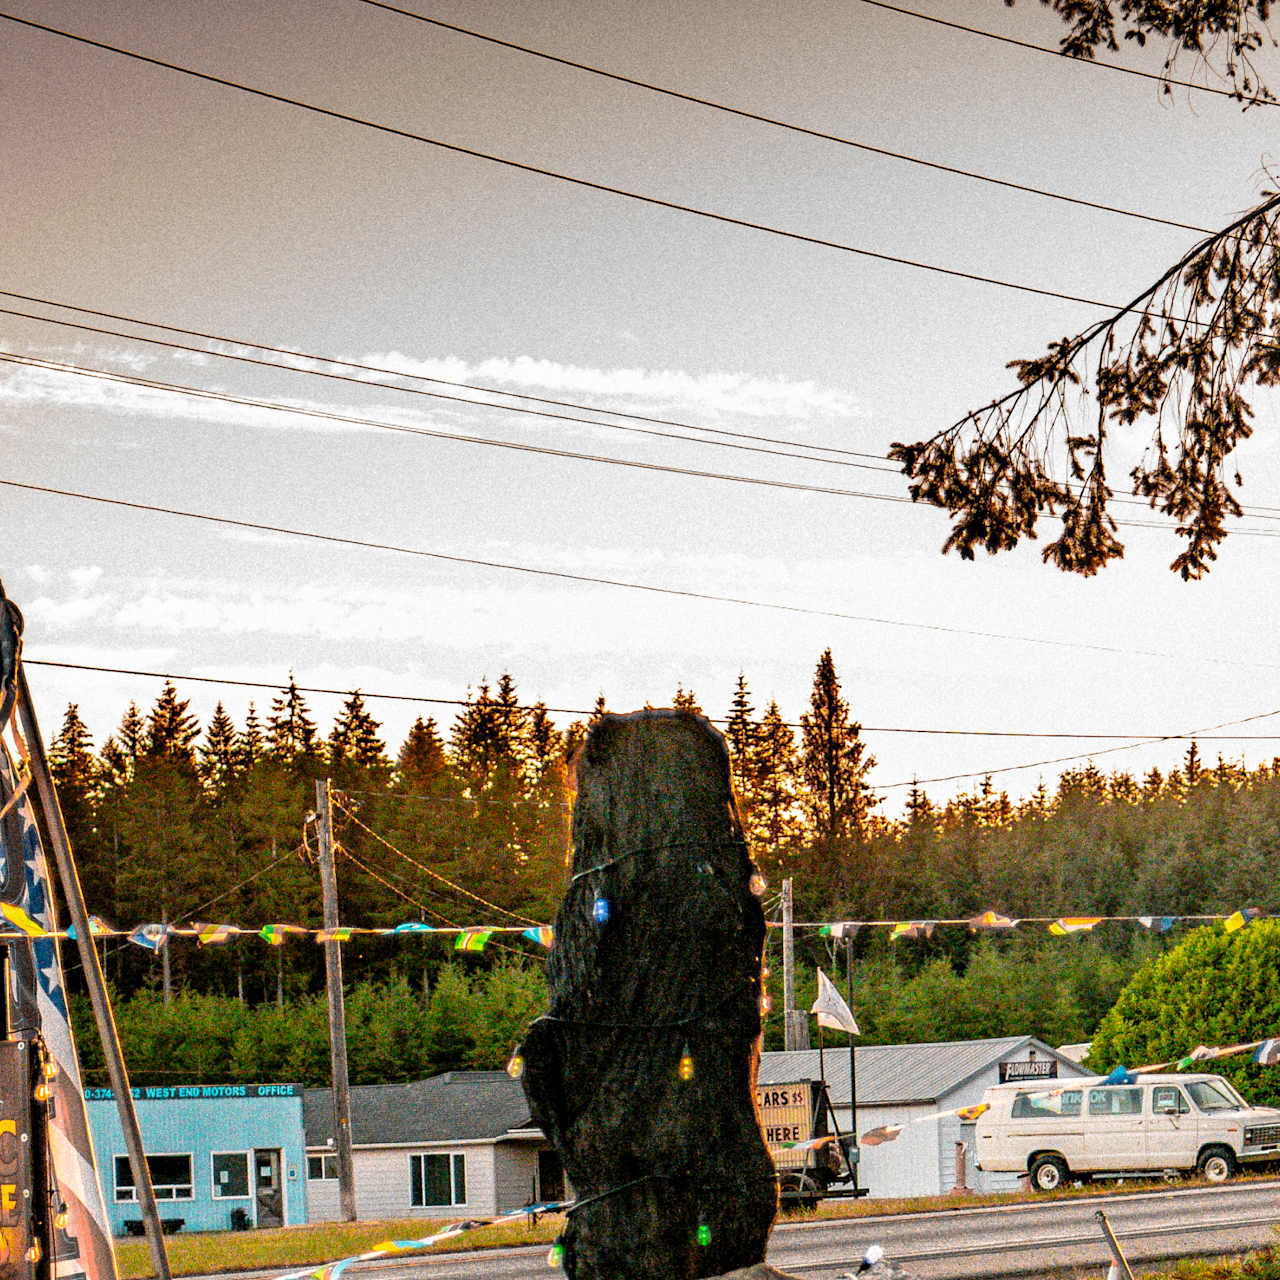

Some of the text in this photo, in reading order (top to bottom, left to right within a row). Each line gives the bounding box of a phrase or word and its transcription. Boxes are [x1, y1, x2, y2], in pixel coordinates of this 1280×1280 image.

[146, 1087, 177, 1098] WEST
[179, 1087, 201, 1097] END
[202, 1086, 246, 1097] MOTORS
[257, 1085, 294, 1096] OFFICE
[766, 1127, 800, 1141] HERE
